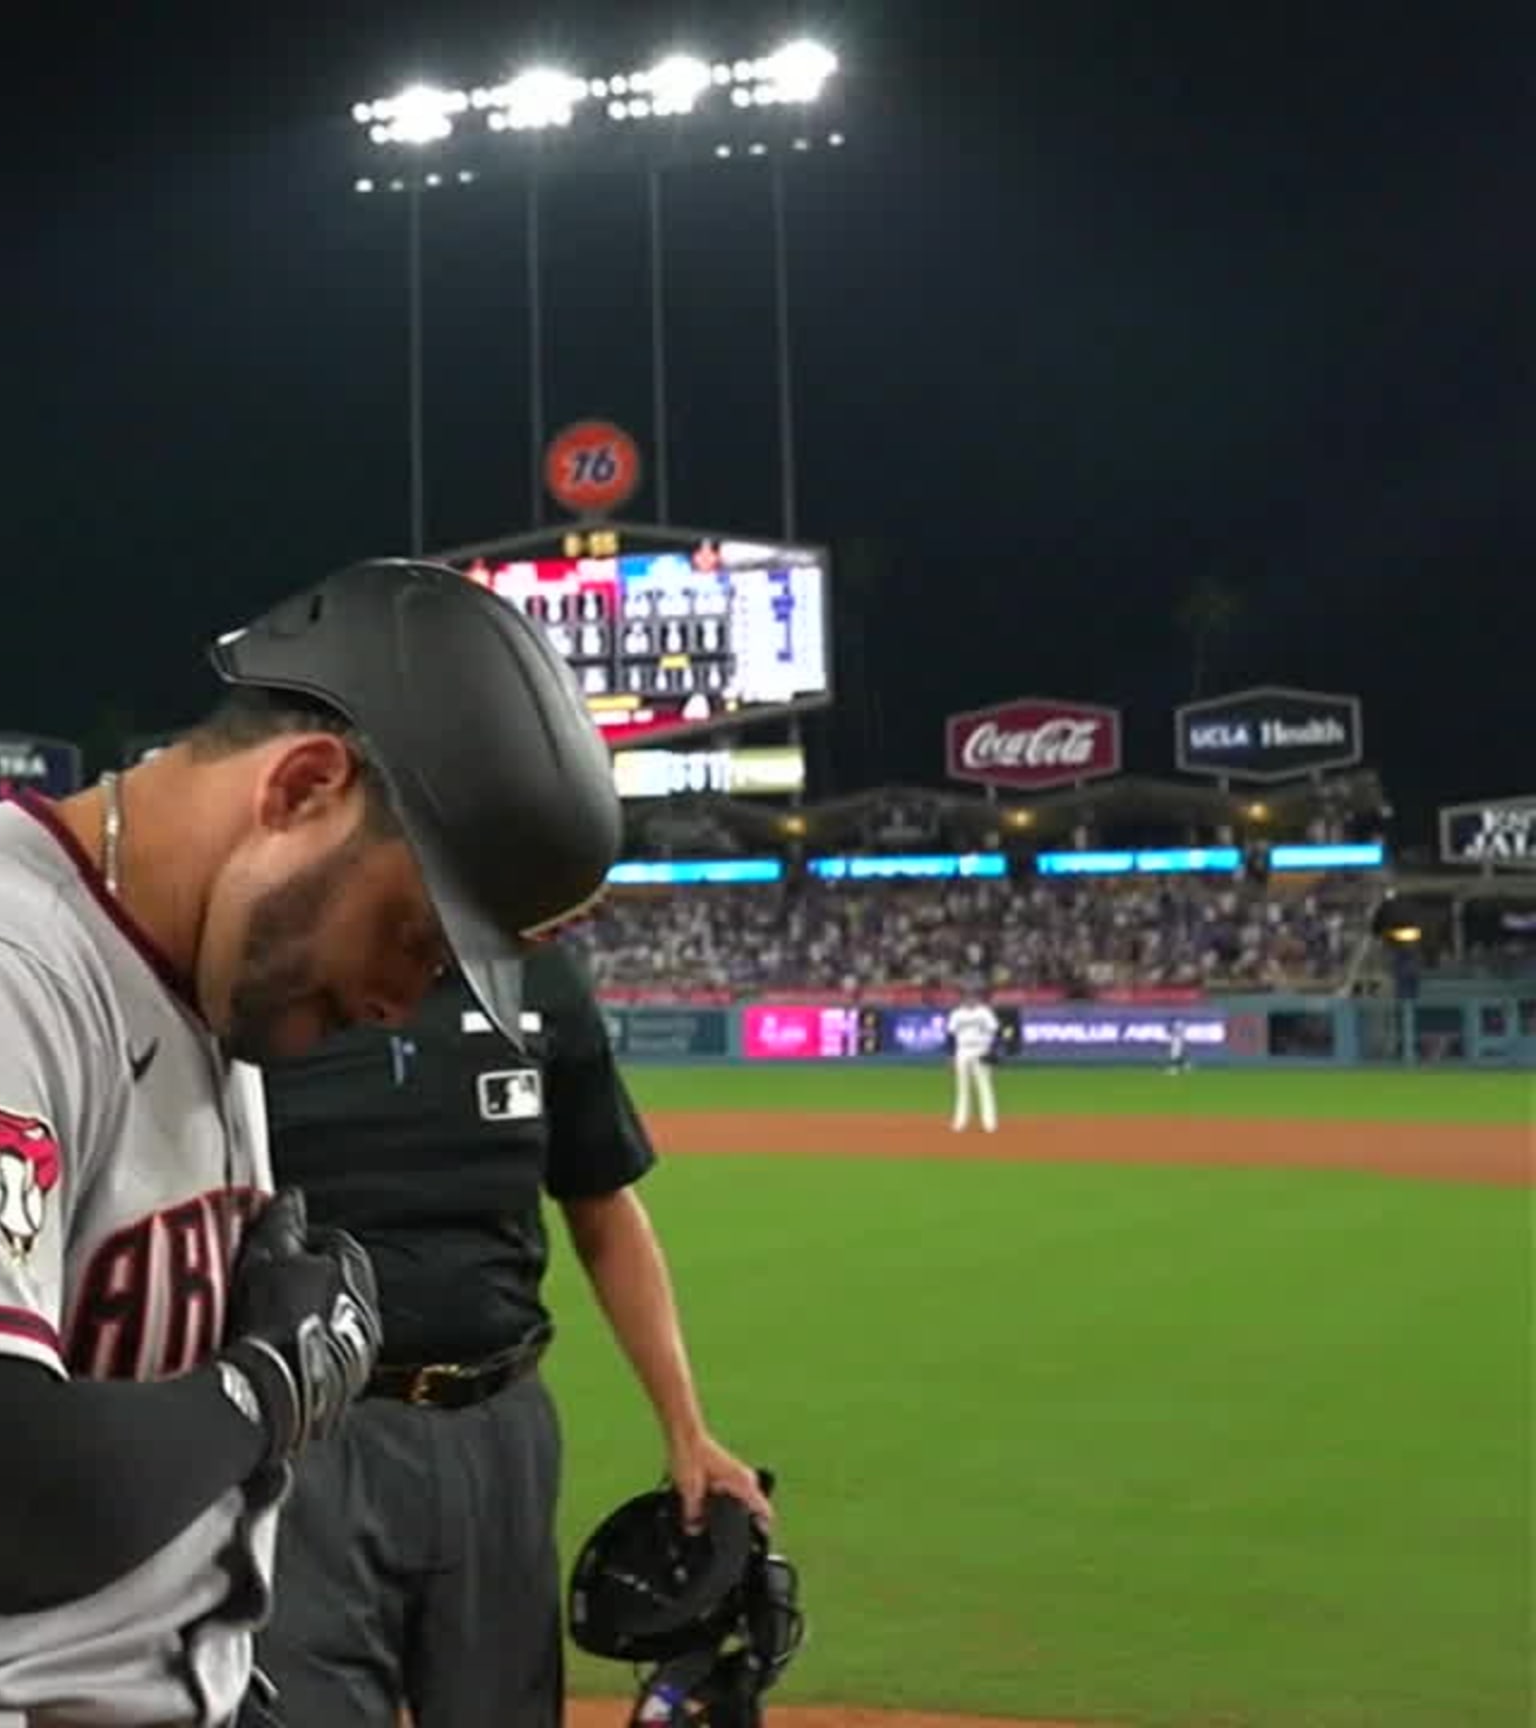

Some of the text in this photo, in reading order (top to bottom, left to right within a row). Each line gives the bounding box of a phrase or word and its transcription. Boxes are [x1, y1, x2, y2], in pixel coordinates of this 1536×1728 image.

[573, 447, 616, 484] 76
[1190, 717, 1345, 750] UCLA Health
